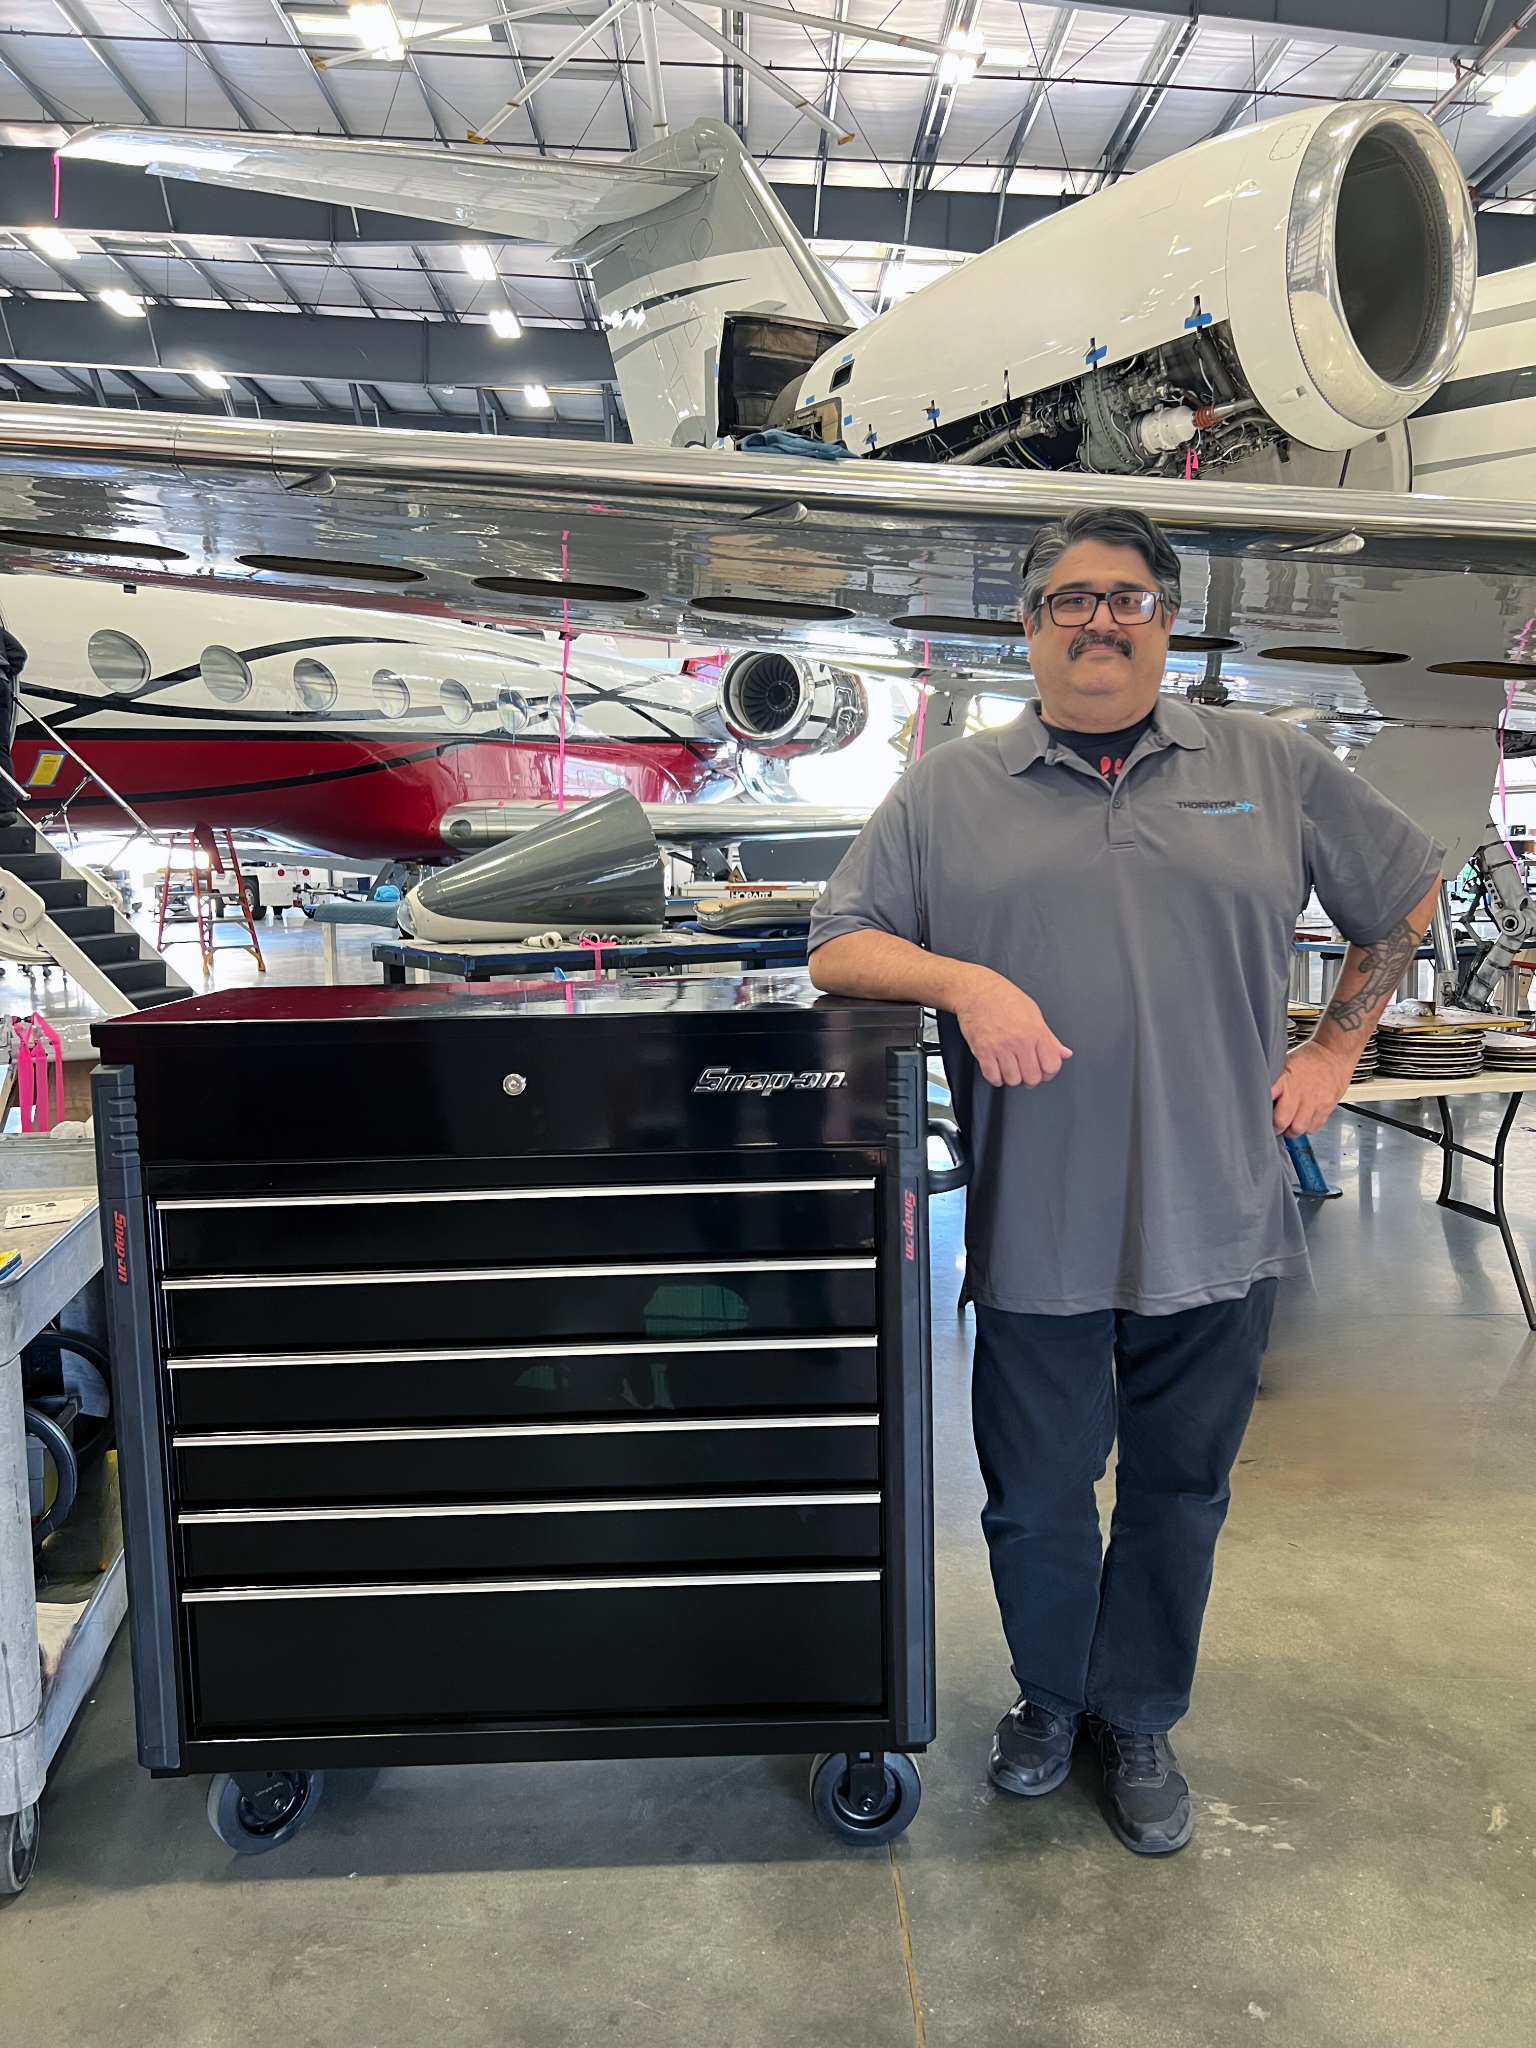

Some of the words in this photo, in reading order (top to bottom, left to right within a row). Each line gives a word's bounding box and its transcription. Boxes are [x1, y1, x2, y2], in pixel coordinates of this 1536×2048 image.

[1176, 801, 1236, 809] THORNTON
[692, 1065, 847, 1097] Snap-on
[114, 1210, 128, 1283] Snap-on
[902, 1189, 916, 1261] Snap-on
